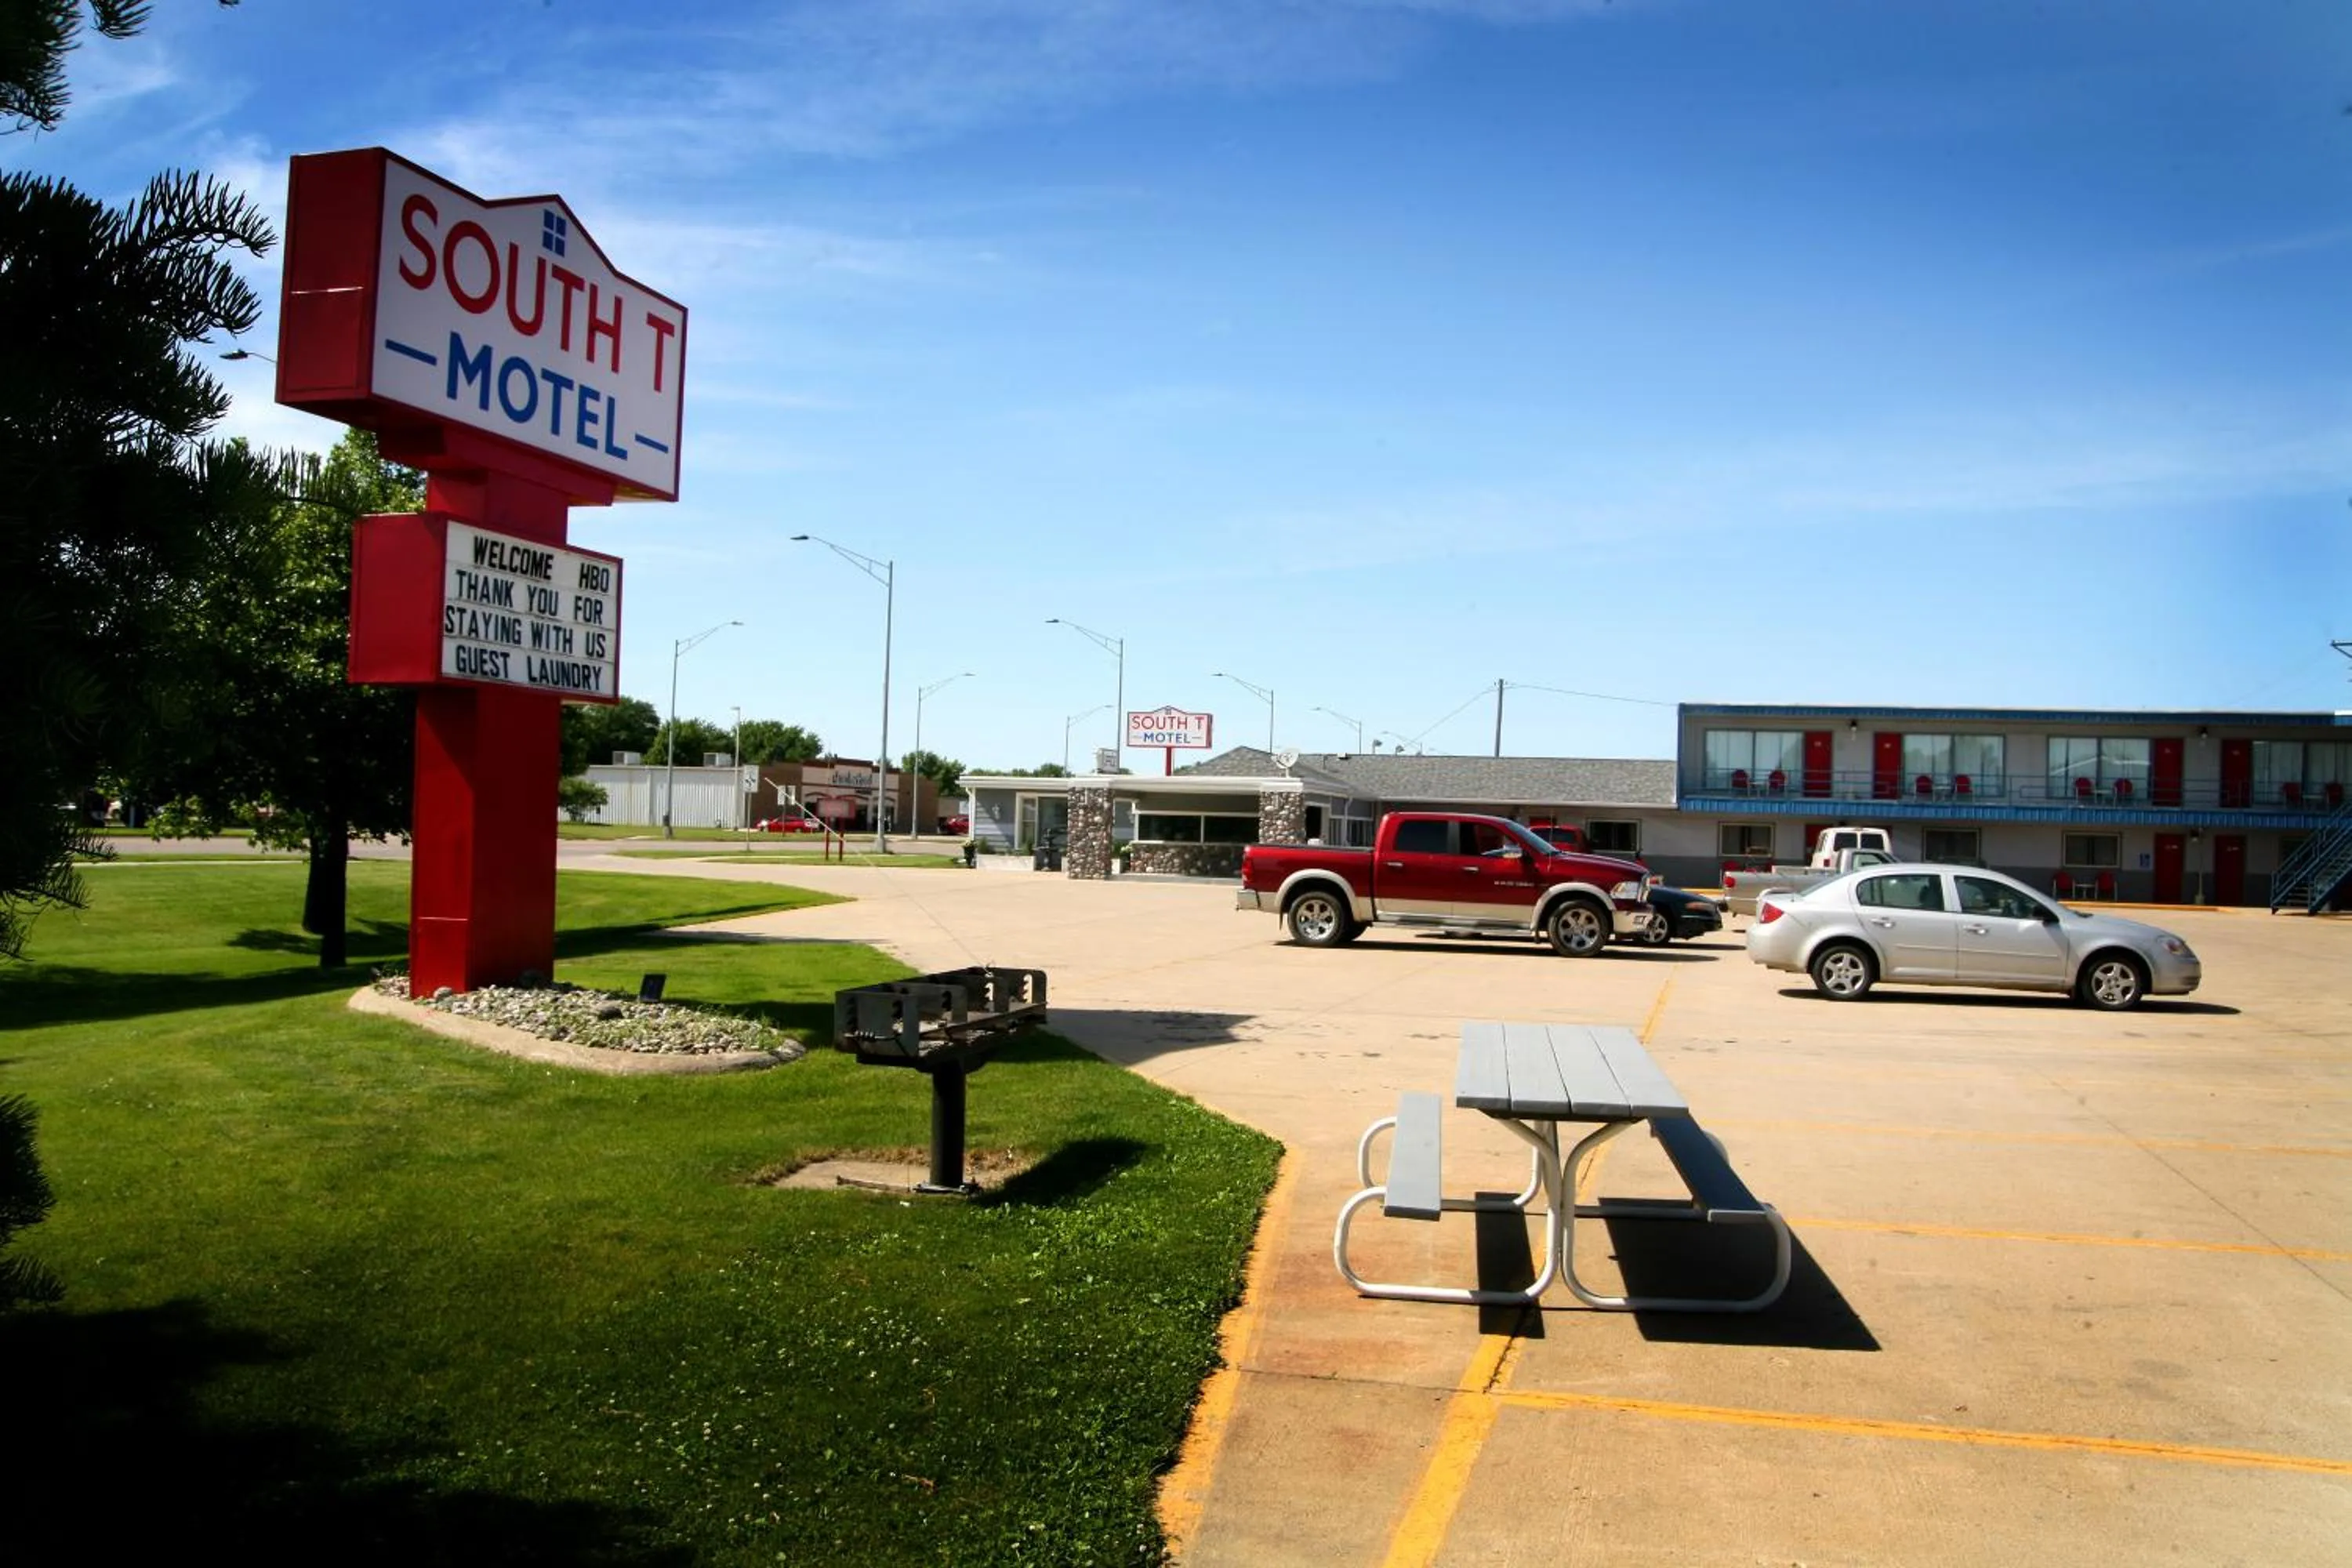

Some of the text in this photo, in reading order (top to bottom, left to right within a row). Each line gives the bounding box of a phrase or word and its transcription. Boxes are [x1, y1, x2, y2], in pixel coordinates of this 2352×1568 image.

[399, 194, 675, 392] SOUTH T
[446, 331, 628, 460] MOTEL
[474, 536, 610, 593] WELCOME HBO
[456, 569, 603, 625] THANK YOU FOR
[445, 605, 606, 658] STAYING WITH US
[456, 645, 602, 691] GUEST LAUNDRY
[1131, 716, 1204, 730] SOUTH T
[1144, 732, 1191, 744] MOTEL
